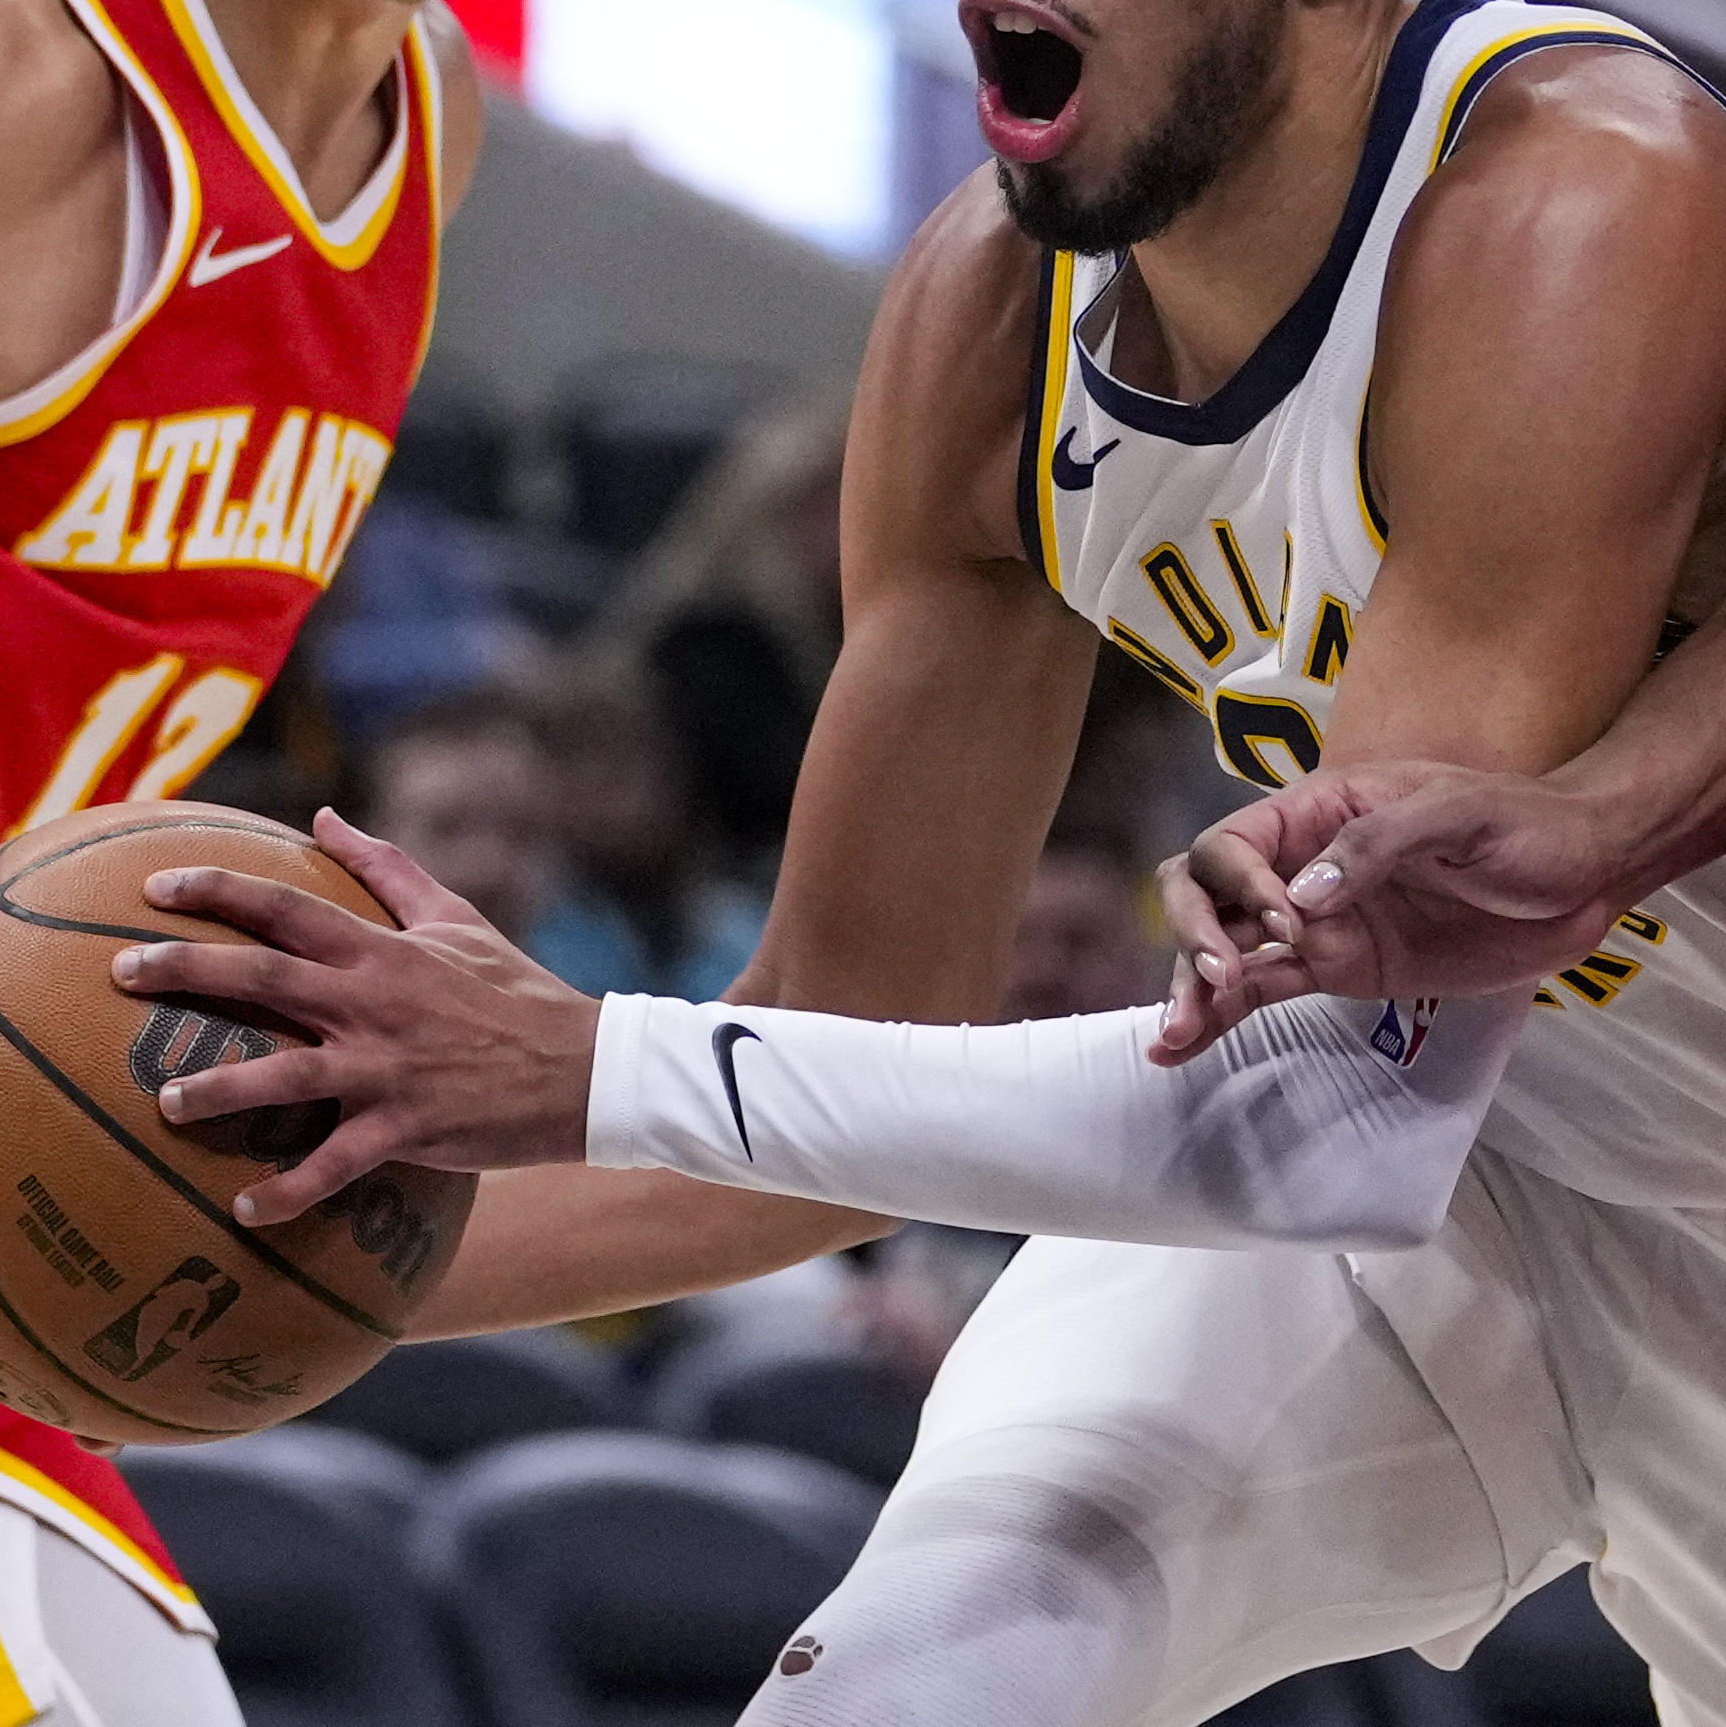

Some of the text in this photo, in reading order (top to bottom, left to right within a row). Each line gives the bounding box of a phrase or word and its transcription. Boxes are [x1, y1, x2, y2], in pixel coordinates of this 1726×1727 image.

[12, 406, 393, 590] ATLANT
[1374, 1028, 1402, 1056] NBA
[17, 1174, 71, 1236] OFFICIAL
[59, 1227, 101, 1269] GAME
[88, 1258, 127, 1294] BALL
